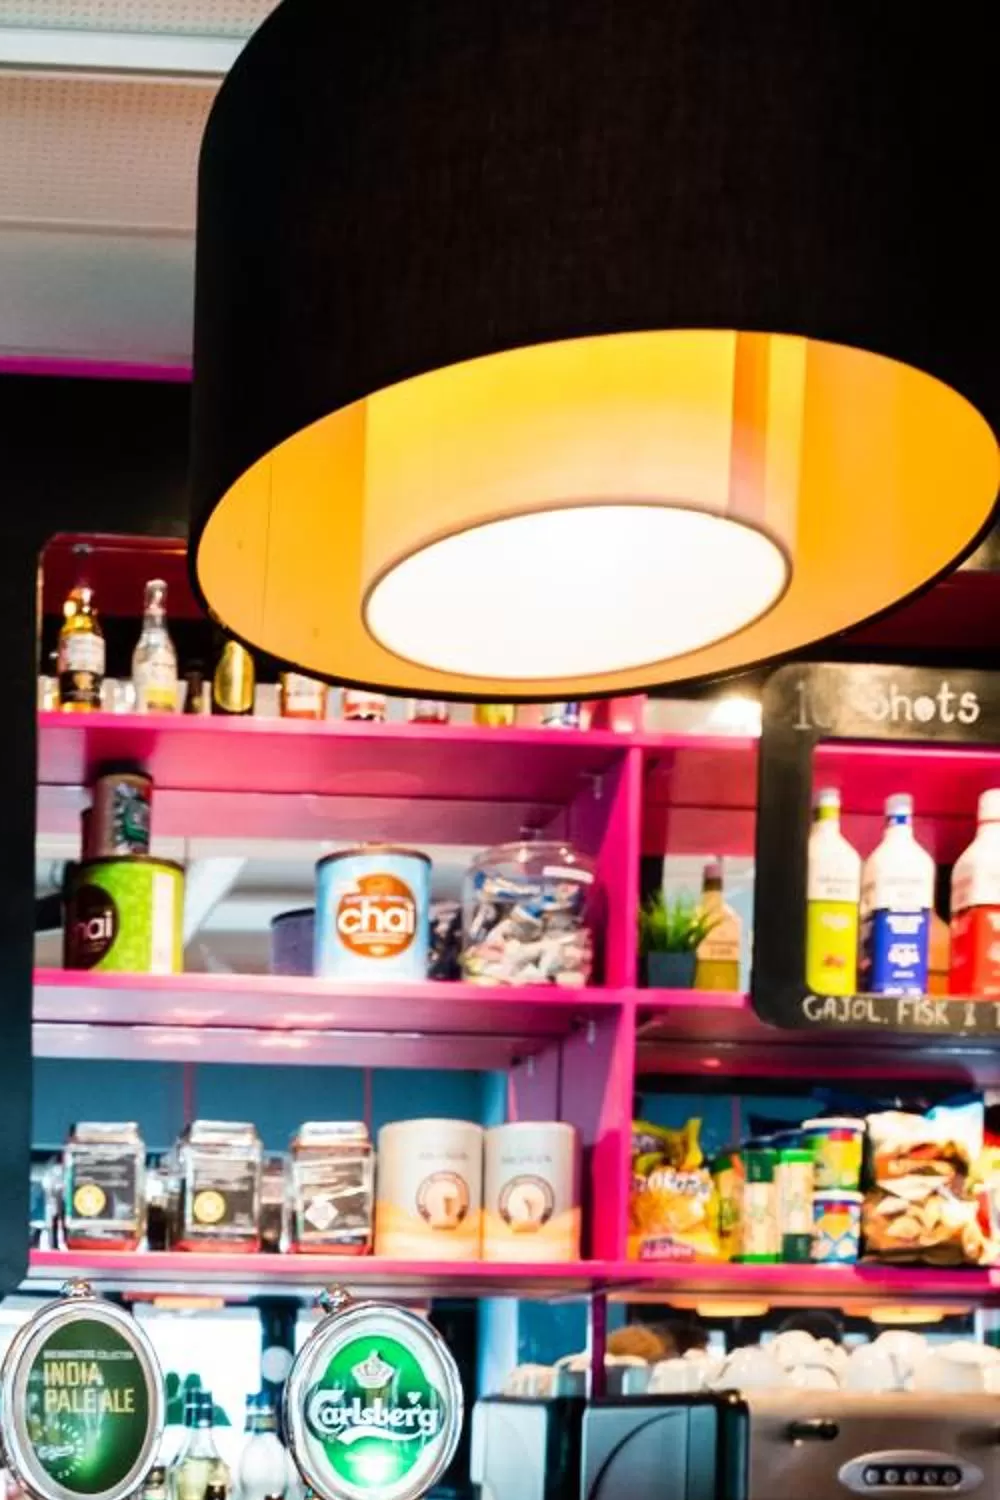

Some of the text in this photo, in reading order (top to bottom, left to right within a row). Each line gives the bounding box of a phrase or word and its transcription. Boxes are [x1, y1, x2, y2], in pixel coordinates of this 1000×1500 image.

[338, 899, 416, 934] chai
[897, 997, 949, 1026] FISK
[43, 1361, 105, 1387] INDIA
[44, 1387, 136, 1413] PALE ALE
[309, 1389, 438, 1444] Carlsberg
